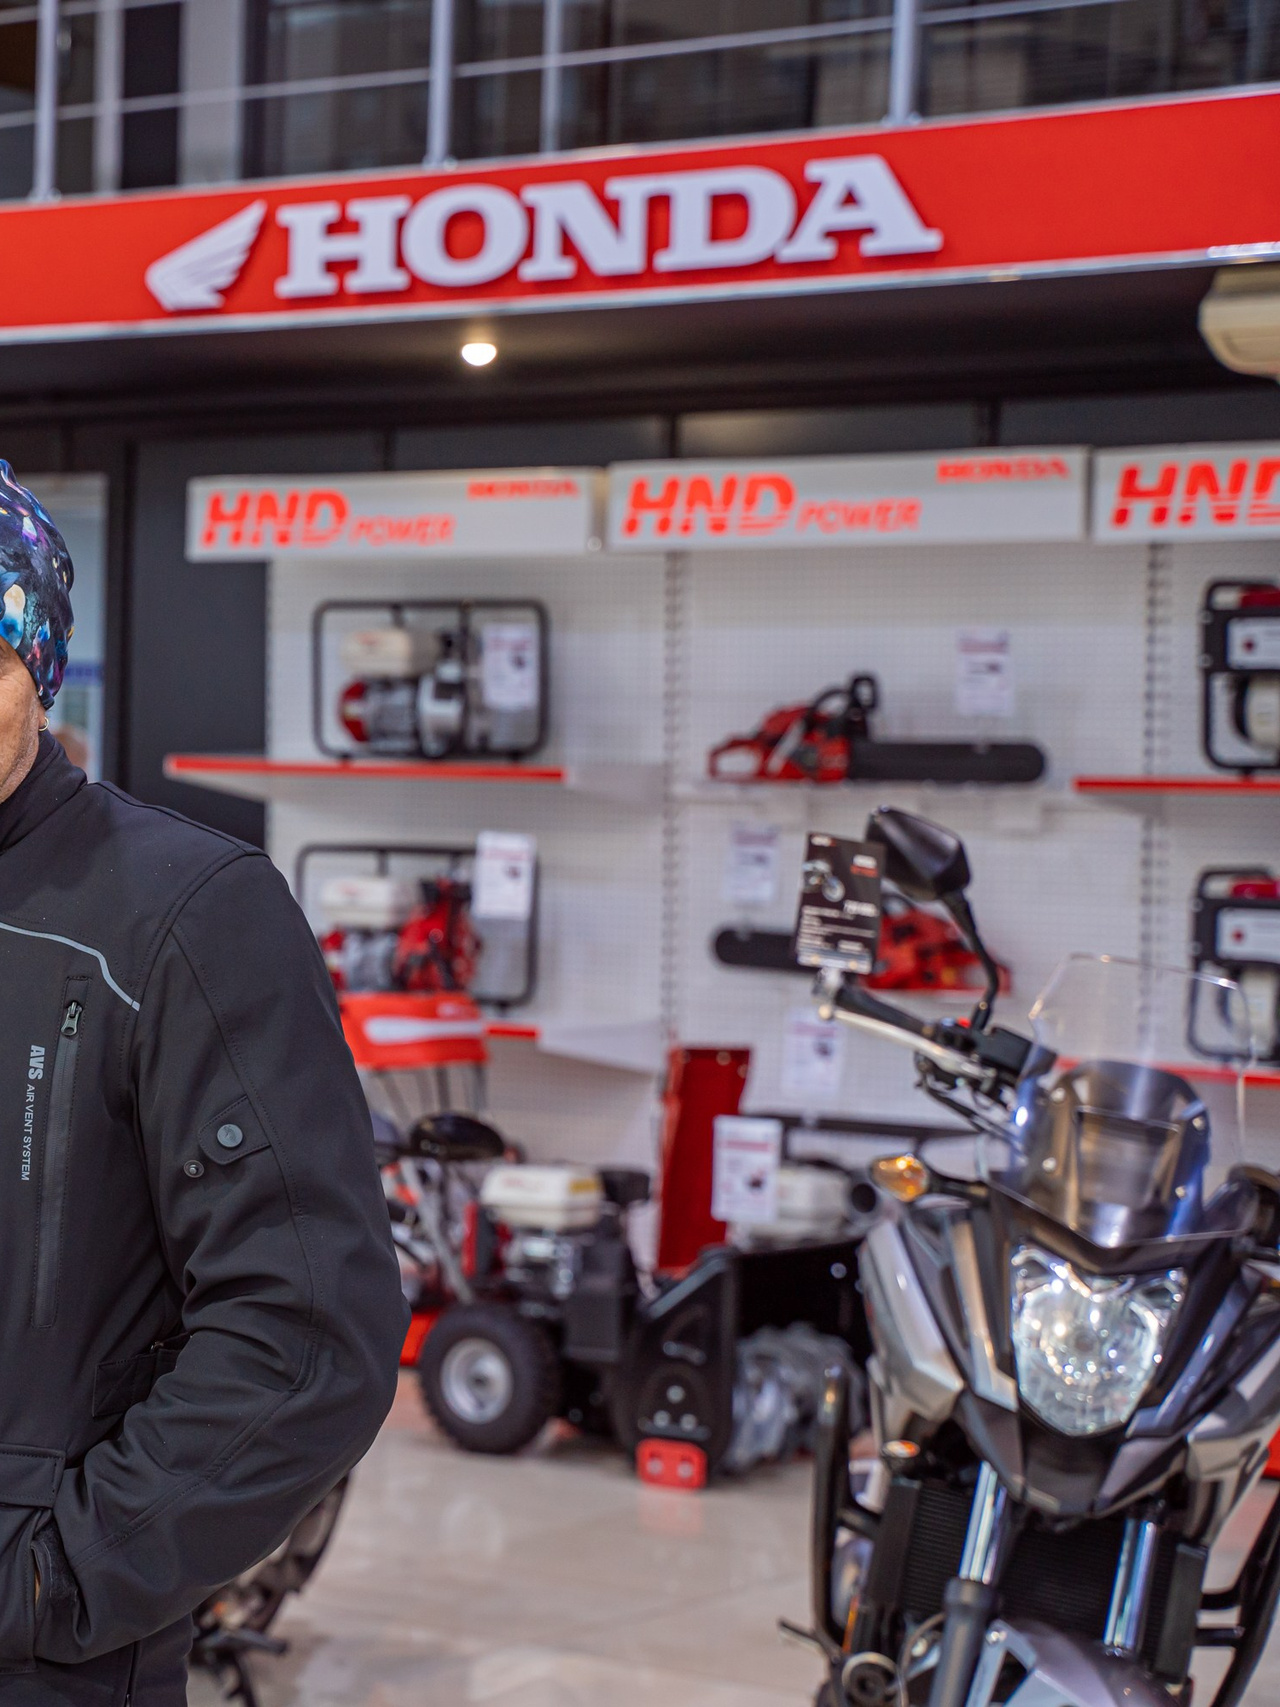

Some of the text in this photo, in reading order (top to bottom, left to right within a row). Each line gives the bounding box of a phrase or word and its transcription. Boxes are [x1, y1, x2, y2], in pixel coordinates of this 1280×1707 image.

[274, 154, 943, 300] HONDA
[201, 487, 455, 548] HND POWER
[623, 472, 922, 537] HND POWER
[22, 1044, 46, 1180] AVS AIR VENT SYSTEM
